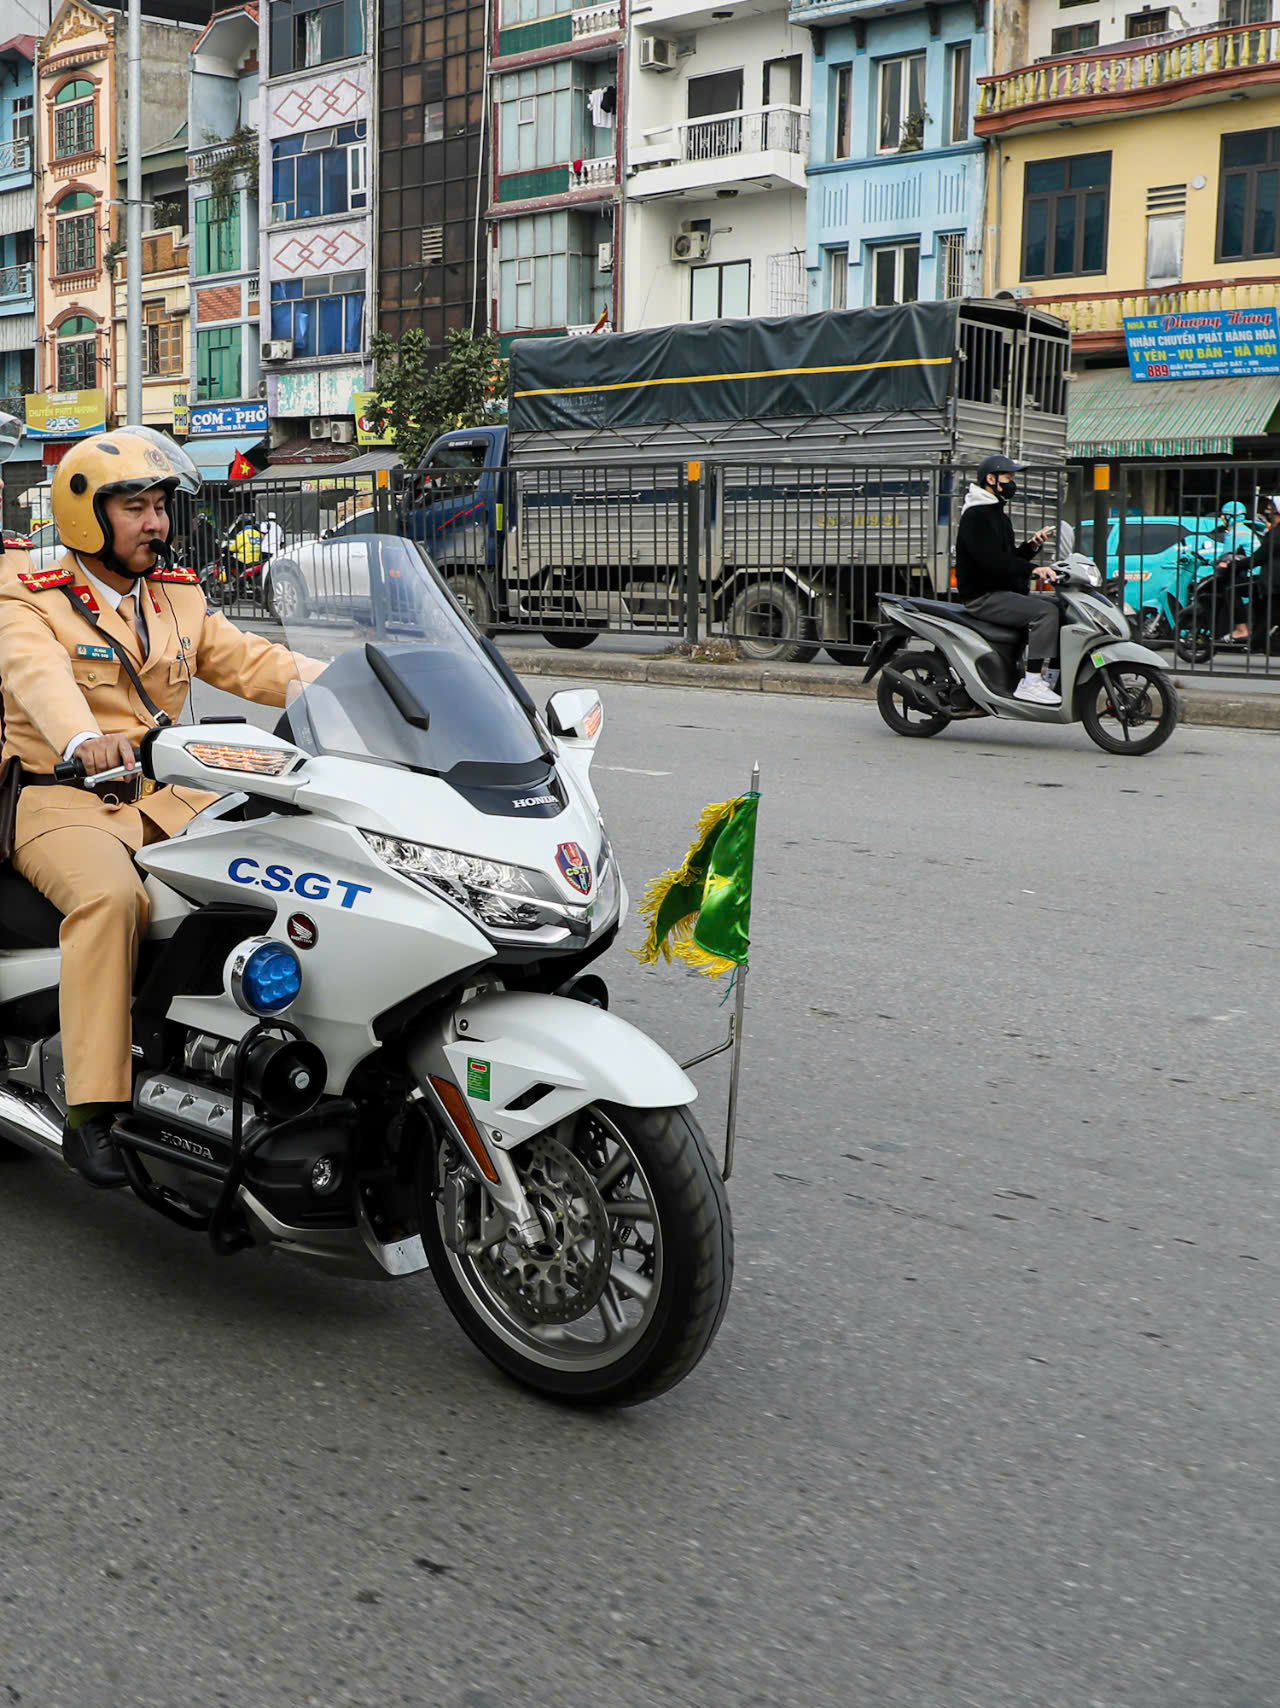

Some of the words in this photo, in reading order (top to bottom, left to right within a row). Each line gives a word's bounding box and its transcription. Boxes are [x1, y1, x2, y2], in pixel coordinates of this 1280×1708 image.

[1126, 320, 1146, 330] NHÀ
[1148, 320, 1159, 329] XE
[1129, 334, 1156, 348] NHẬN
[1158, 330, 1196, 345] CHUYỂN
[1198, 330, 1223, 343] PHÁT
[1226, 330, 1253, 342] HÀNG
[1256, 328, 1276, 340] HÓA
[1143, 348, 1167, 361] YÊN
[1178, 348, 1194, 362] VỤ
[1196, 344, 1223, 358] BẢN
[1234, 344, 1251, 356] HÀ
[1254, 342, 1277, 357] NỘI
[1147, 364, 1169, 377] 889
[192, 412, 224, 425] CƠM
[235, 405, 267, 424] PHỞ
[512, 796, 559, 808] HONDA
[160, 1130, 214, 1160] HONDA
